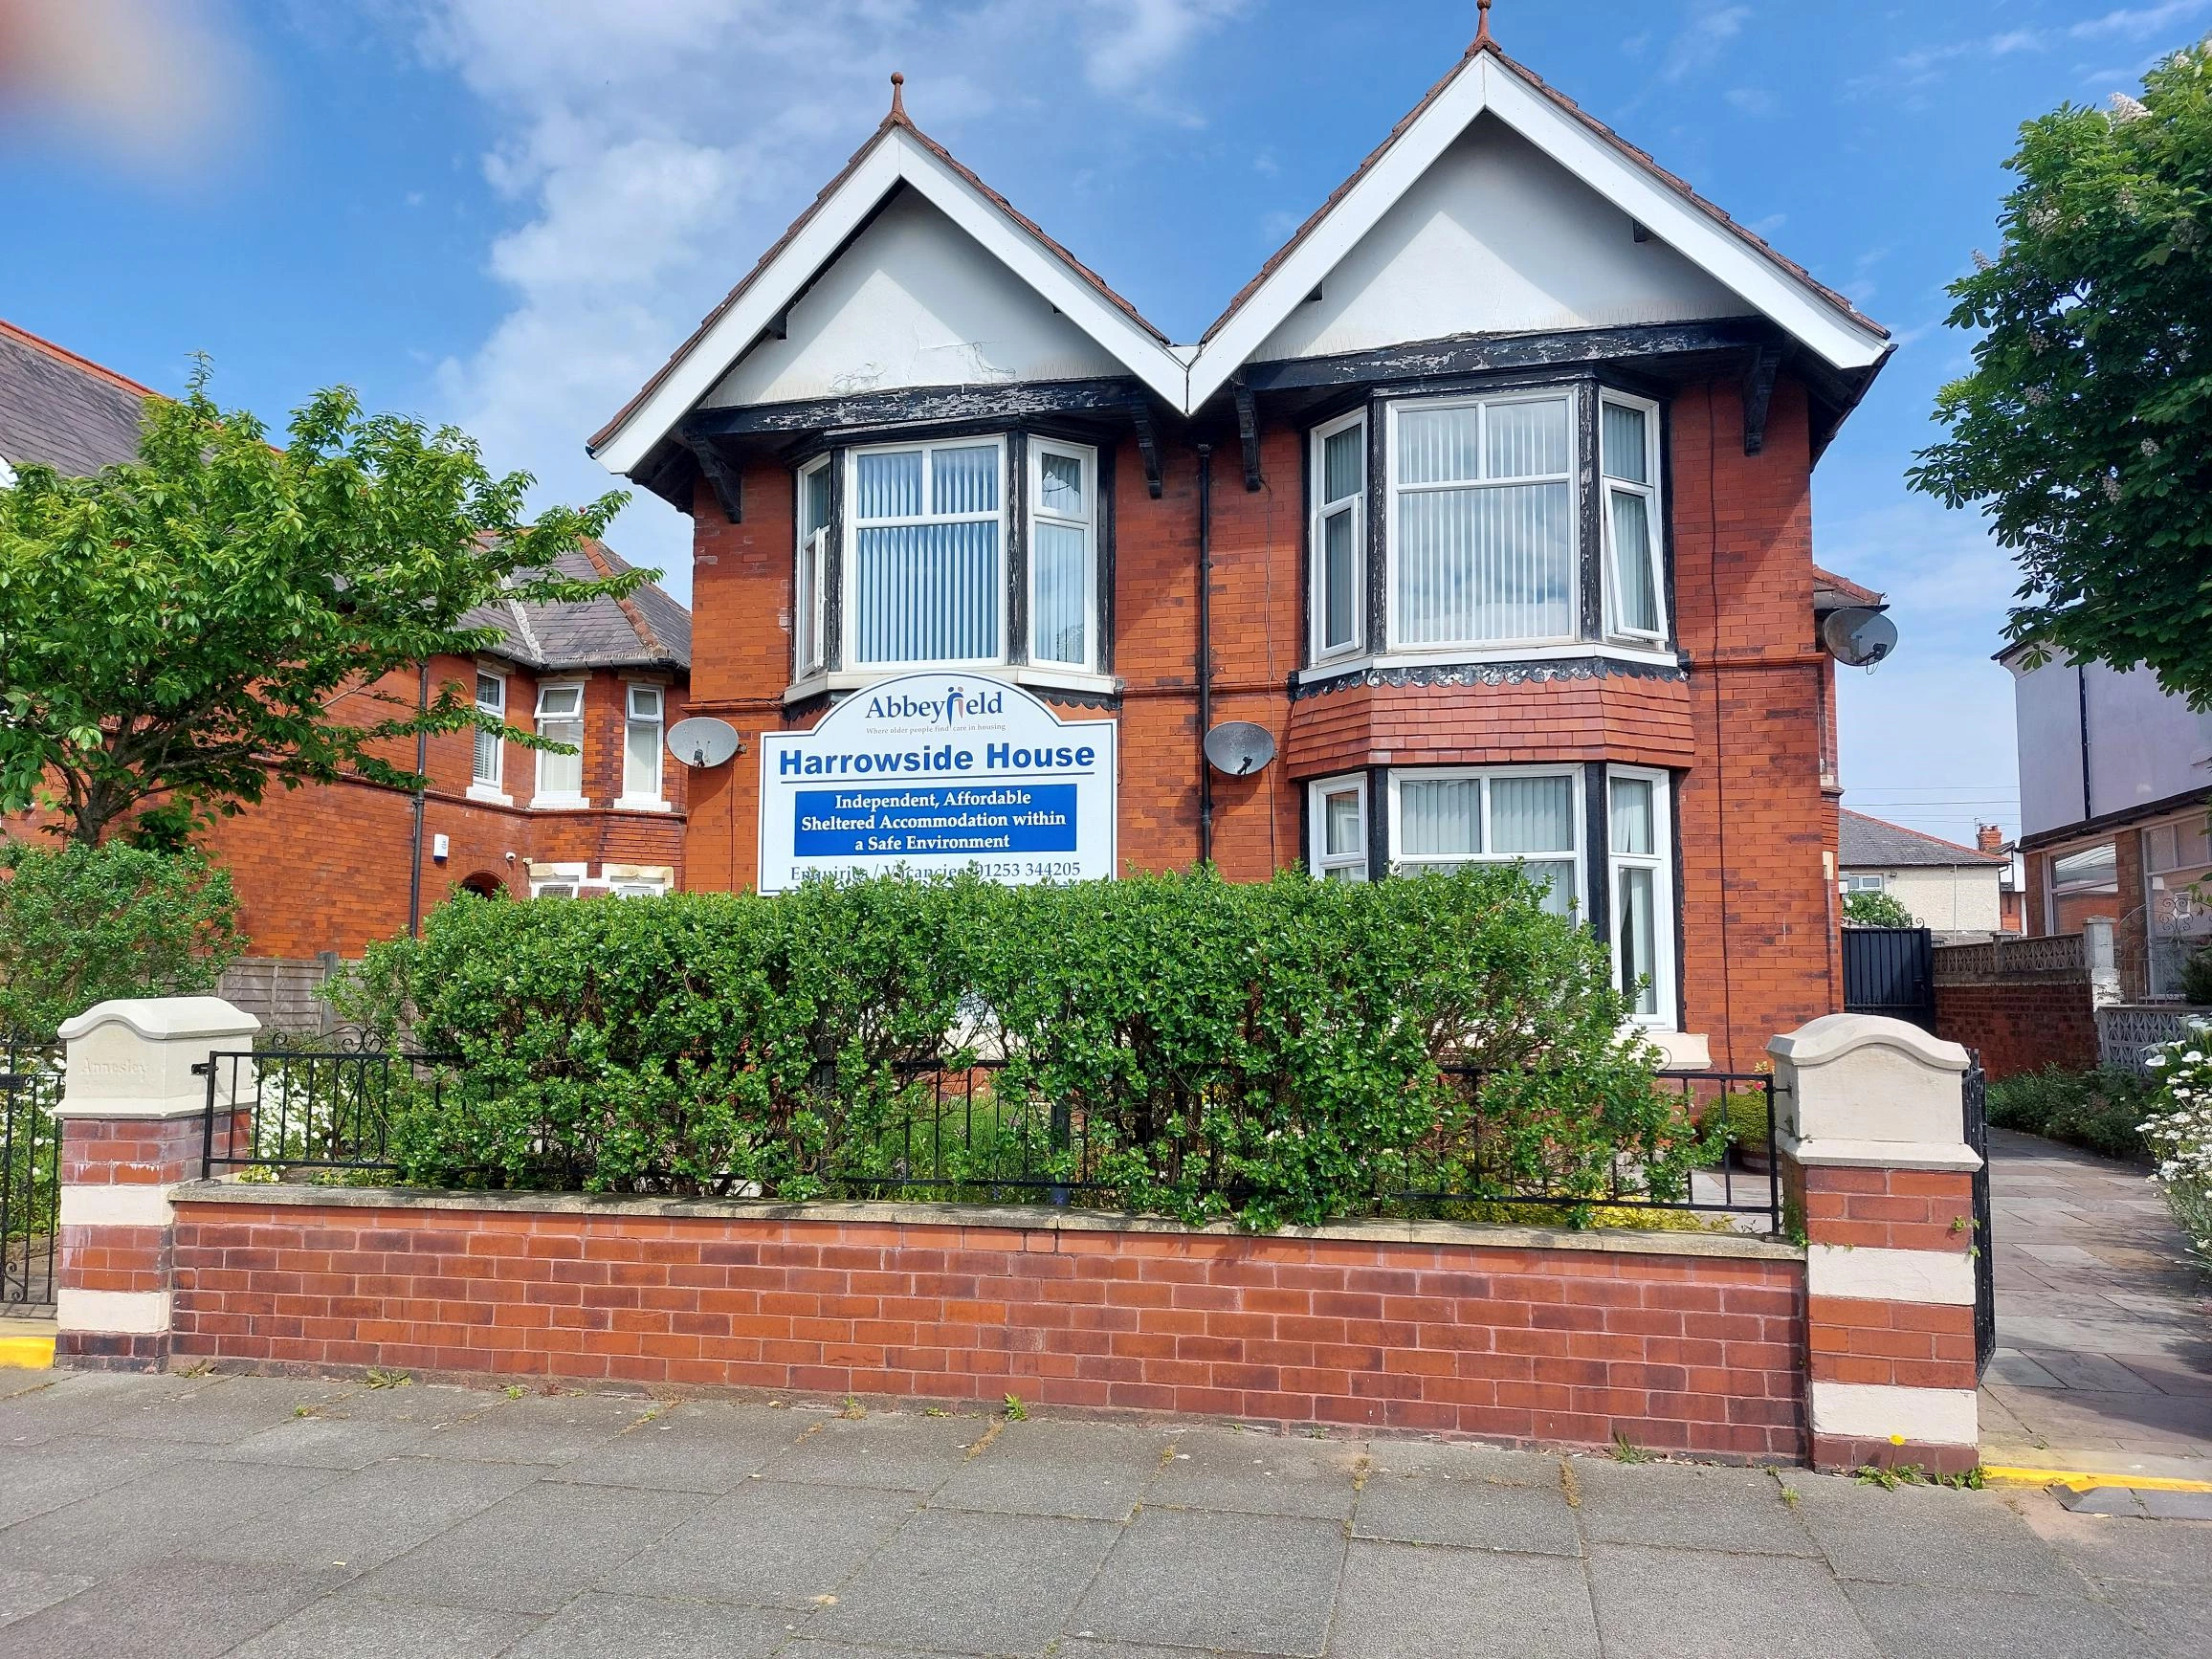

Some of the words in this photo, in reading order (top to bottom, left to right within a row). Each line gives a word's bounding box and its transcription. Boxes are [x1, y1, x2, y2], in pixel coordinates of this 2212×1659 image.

[865, 687, 1003, 727] Abbeyfield
[909, 725, 933, 736] people
[935, 724, 949, 733] find
[978, 722, 1006, 732] housing
[780, 744, 973, 775] Harrowside
[986, 741, 1095, 768] House
[835, 792, 940, 812] Independent,
[943, 789, 1031, 807] Affordable
[802, 815, 874, 830] Sheltered
[879, 812, 1009, 829] Accommodation
[1013, 810, 1066, 826] within
[855, 840, 863, 851] a
[868, 835, 901, 851] Safe
[906, 834, 1010, 850] Environment
[790, 865, 868, 883] Enquiri
[884, 863, 965, 879] Vcancie
[1025, 862, 1080, 876] 344205
